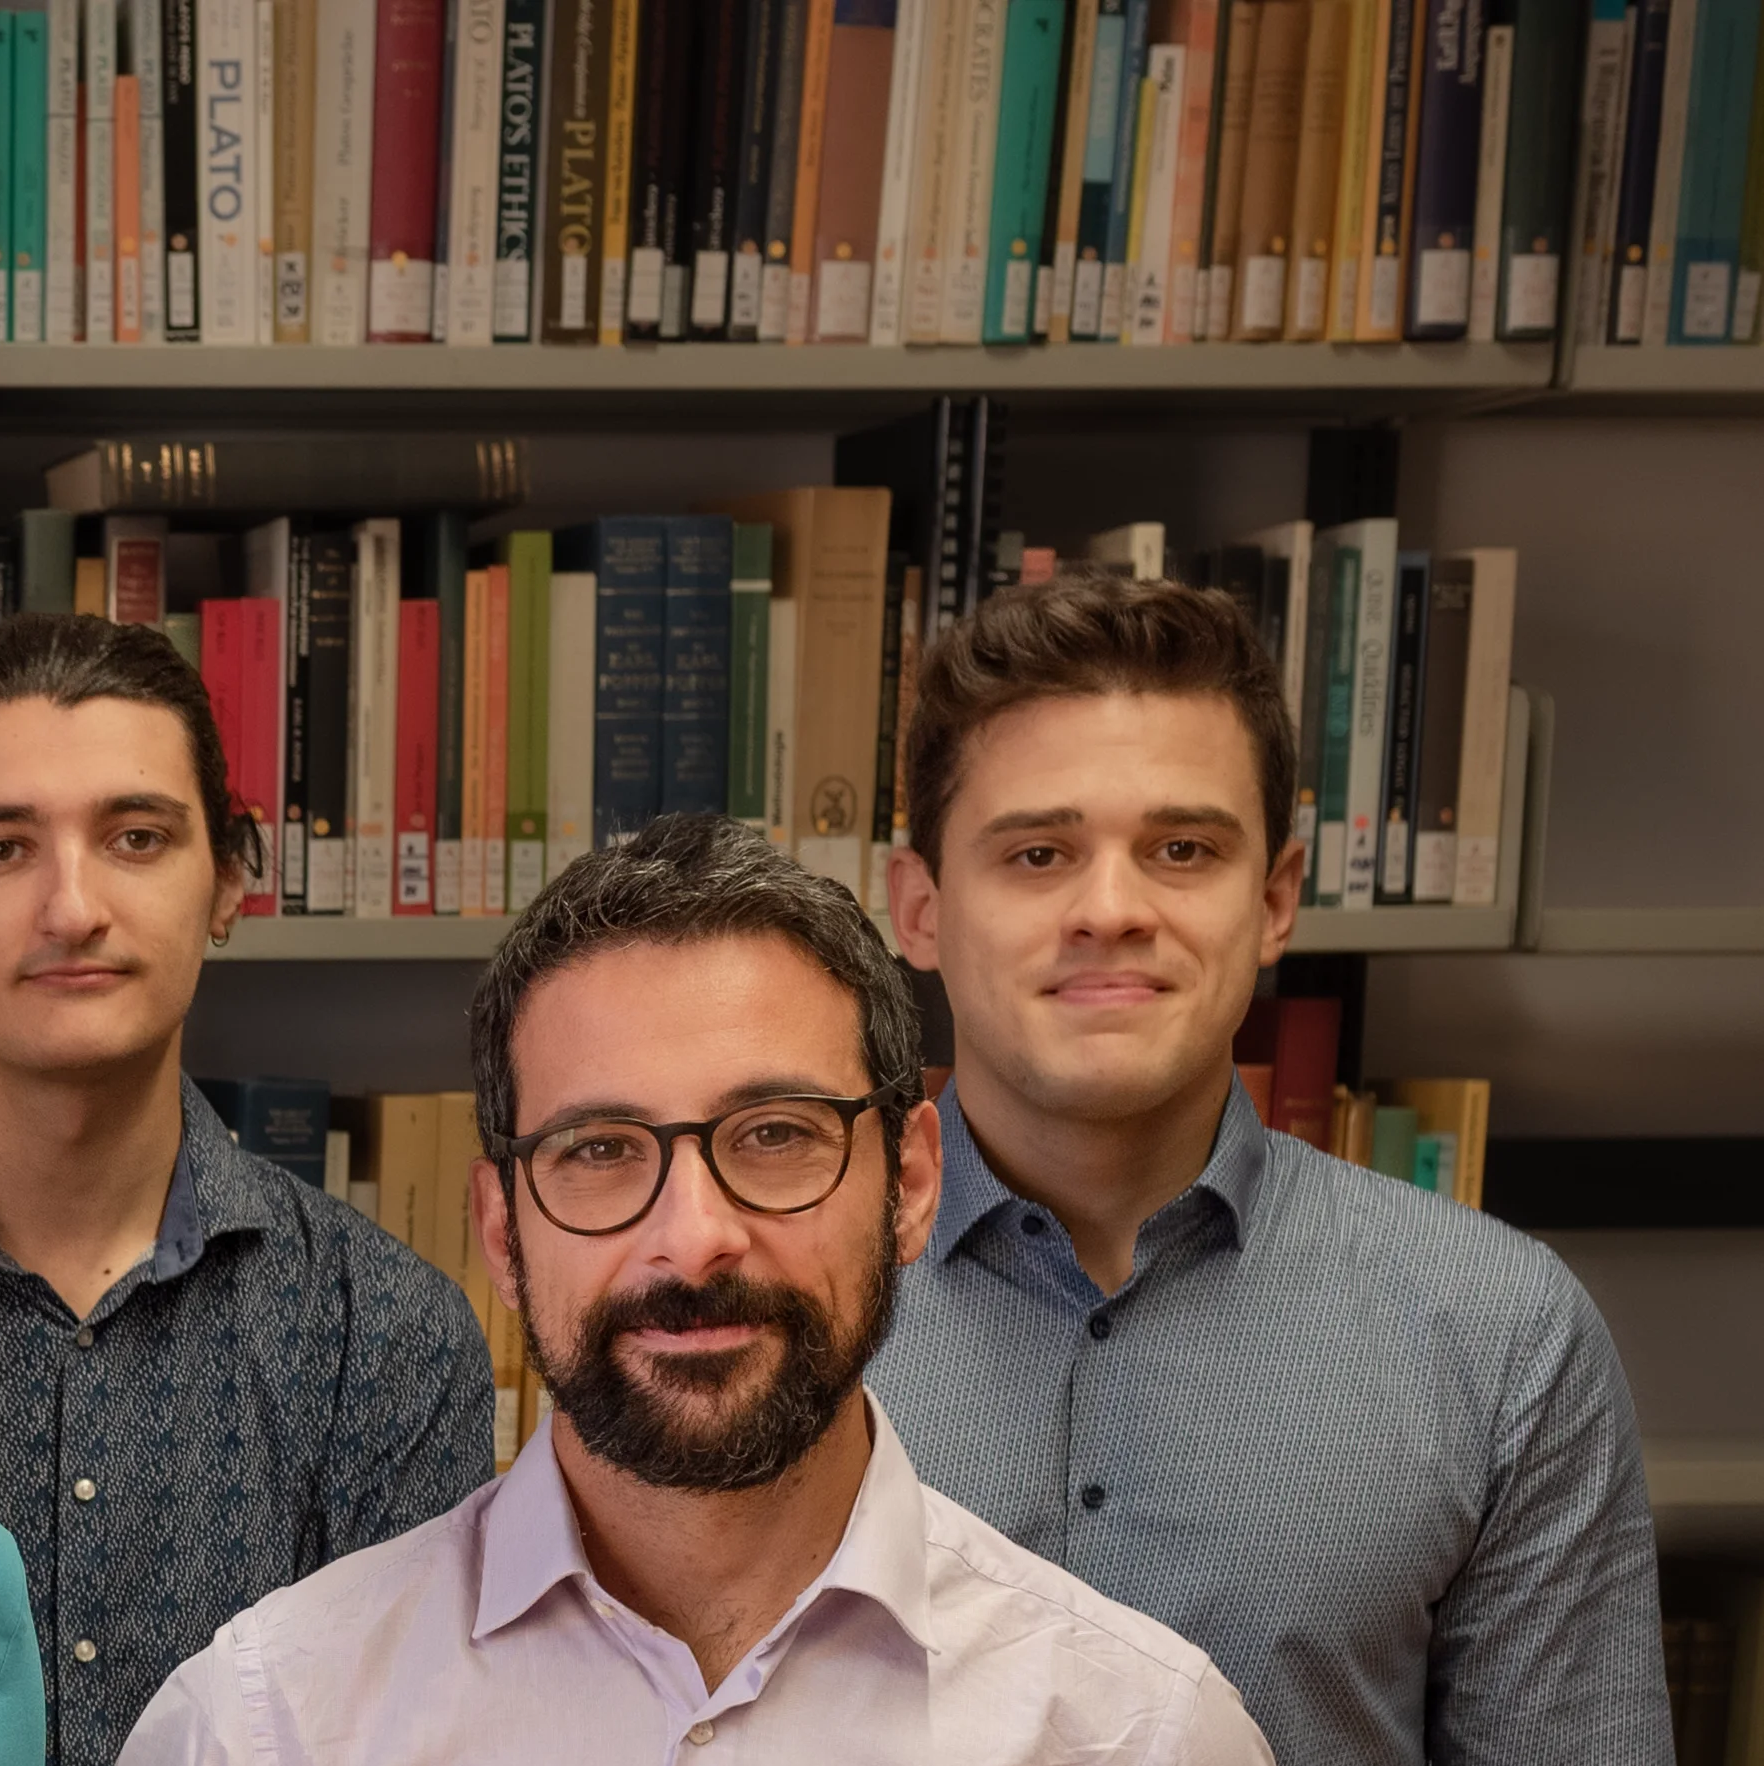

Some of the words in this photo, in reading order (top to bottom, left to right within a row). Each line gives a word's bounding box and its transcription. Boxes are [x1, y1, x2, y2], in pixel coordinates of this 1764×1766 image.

[505, 22, 536, 147] PLATO'S
[968, 0, 997, 104] CRATES
[208, 59, 243, 222] PLATO
[559, 119, 597, 257] PLATO
[500, 154, 531, 262] ETHICS
